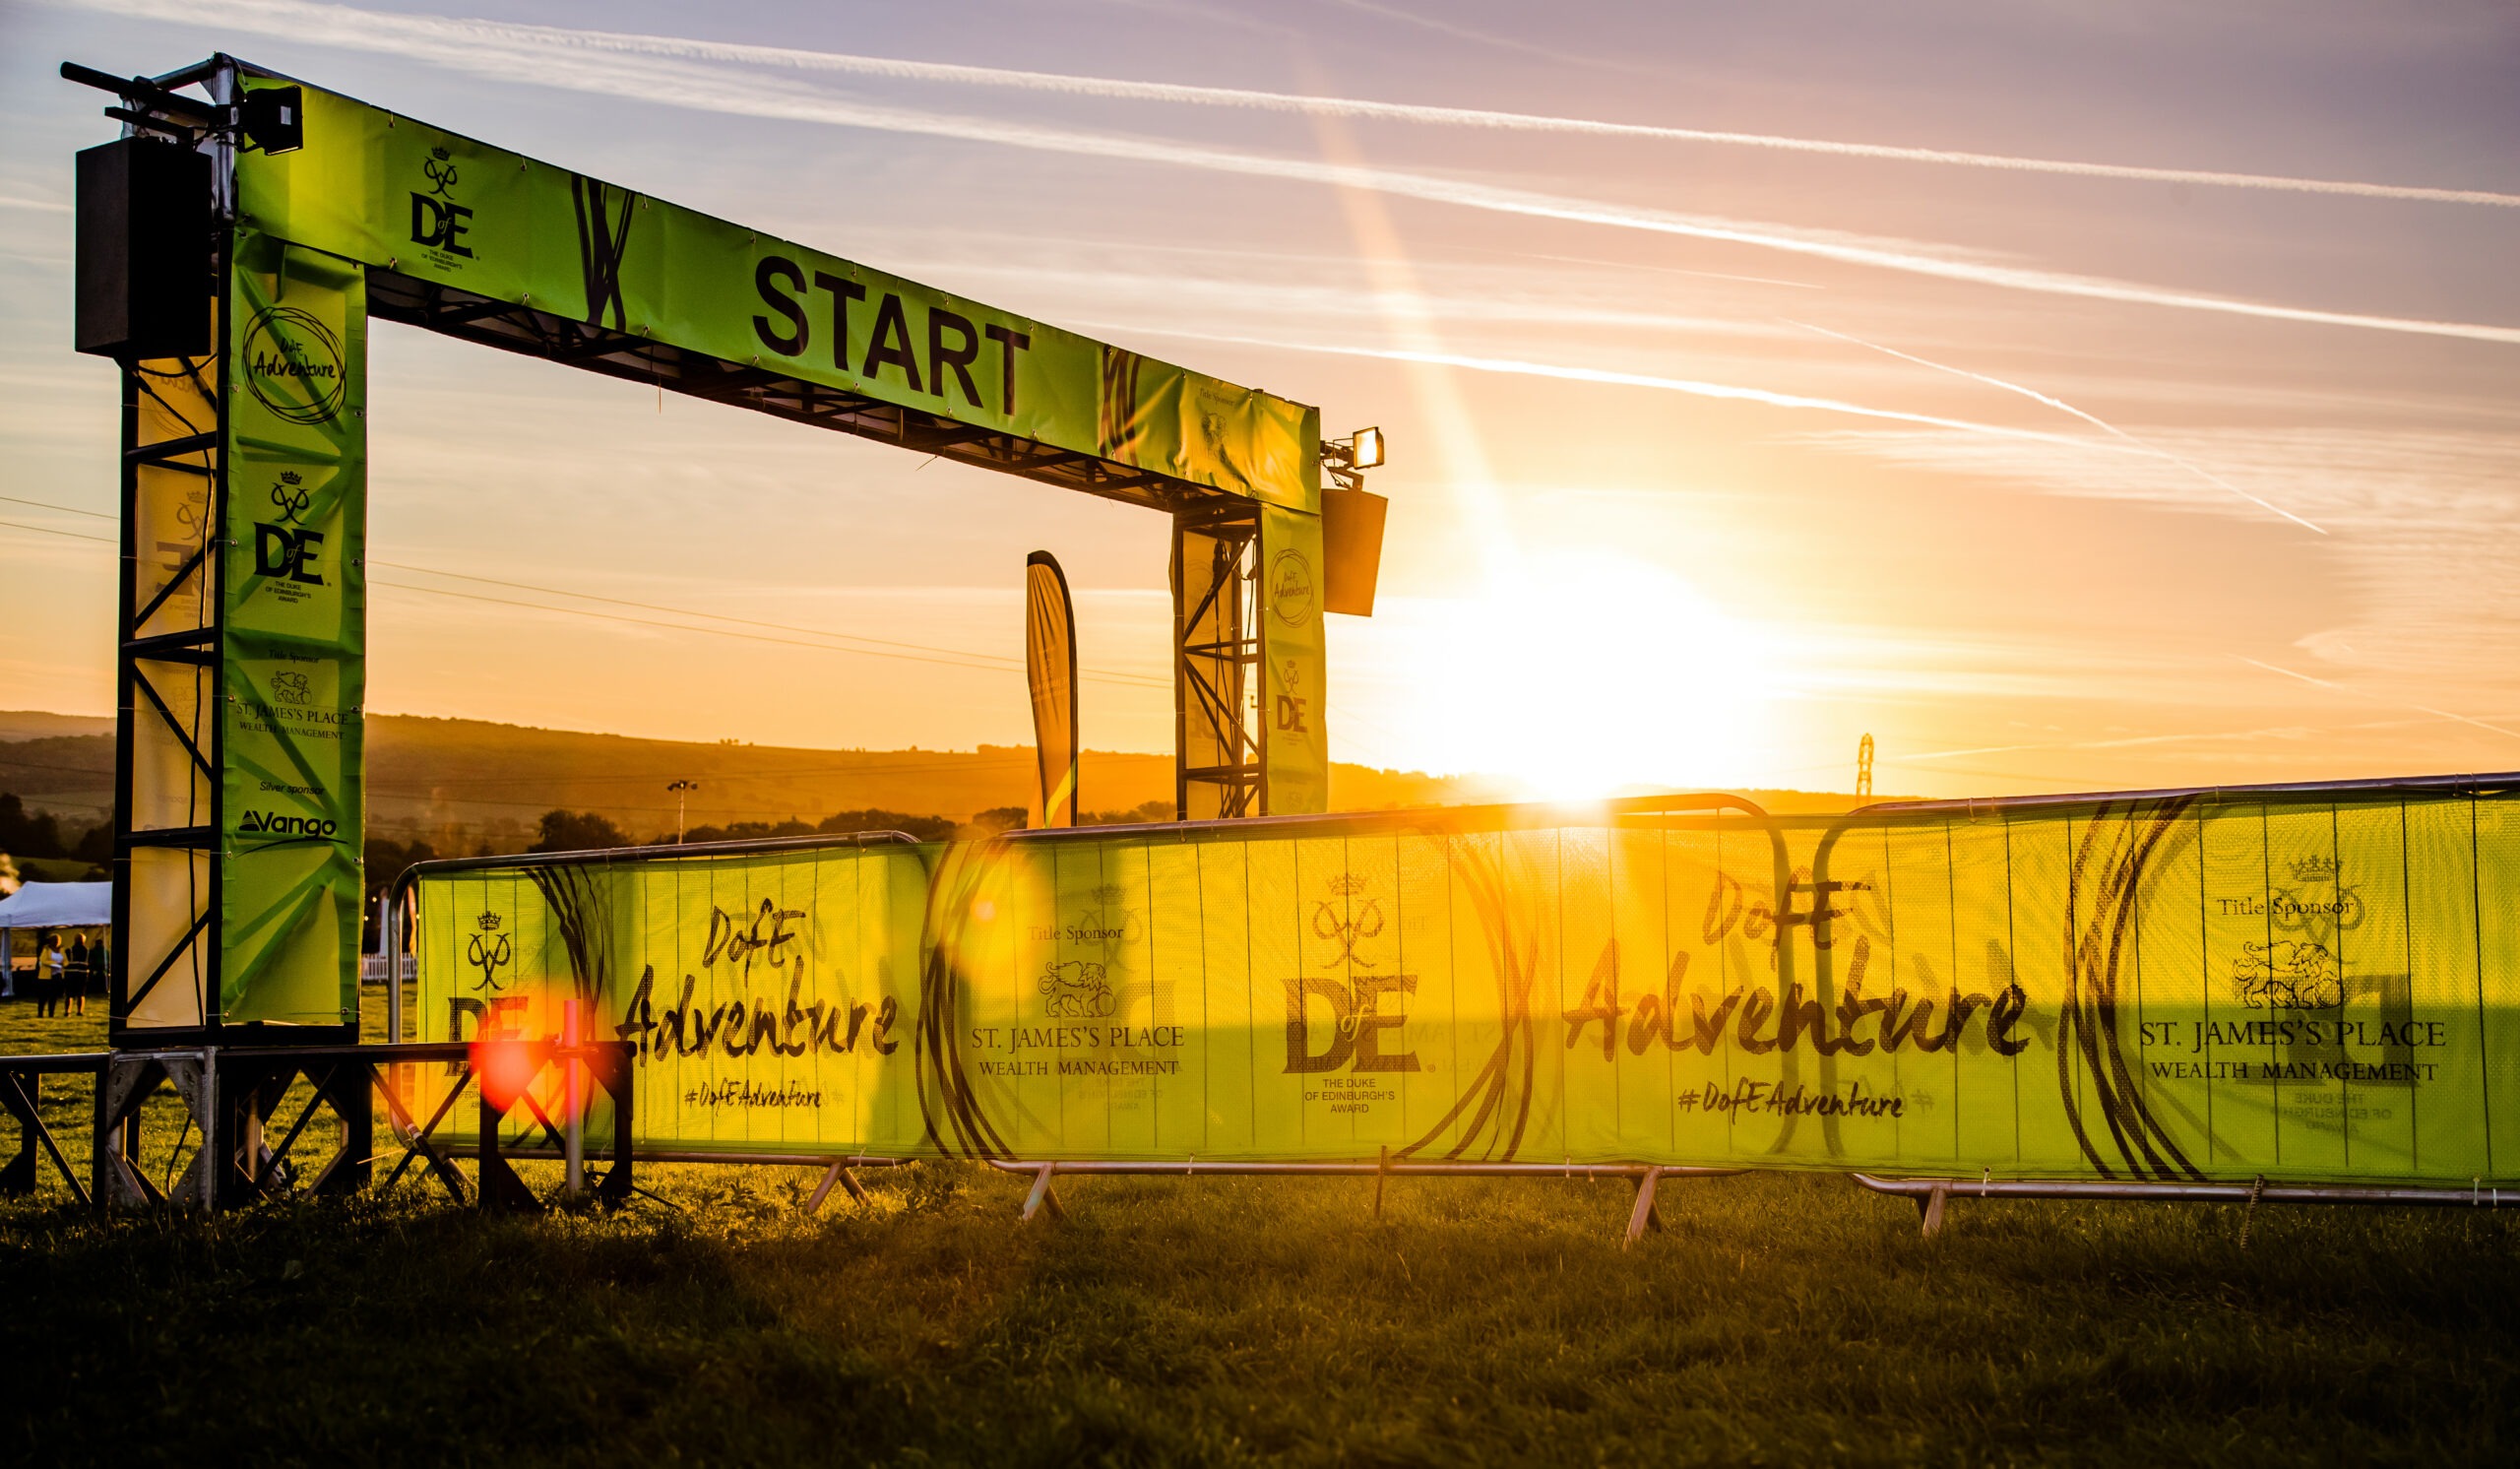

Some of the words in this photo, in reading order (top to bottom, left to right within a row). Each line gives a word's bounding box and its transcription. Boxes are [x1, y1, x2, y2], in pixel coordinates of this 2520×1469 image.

[752, 255, 1031, 416] START
[253, 351, 336, 378] Adventure
[269, 649, 287, 660] Title
[288, 651, 319, 665] Sponsor
[236, 702, 251, 717] ST.
[255, 704, 303, 721] JAMES'S
[307, 711, 348, 726] PLACE
[239, 722, 277, 734] WEALTH
[282, 727, 345, 739] MANAGEMENT
[260, 782, 285, 794] Silver
[286, 784, 325, 797] sponsor
[252, 811, 338, 839] Vango
[2218, 897, 2264, 916] Title
[2272, 897, 2355, 922] Sponsor
[1028, 926, 1060, 940] Title
[1066, 925, 1124, 945] Sponsor
[1562, 935, 2031, 1062] Adventure
[614, 955, 900, 1067] Adventure
[972, 1028, 1001, 1049] ST.
[1008, 1027, 1101, 1054] JAMES'S
[1109, 1027, 1185, 1047] PLACE
[2140, 1022, 2181, 1046] ST.
[2191, 1021, 2323, 1053] JAMES'S
[2334, 1022, 2446, 1047] PLACE
[978, 1061, 1048, 1076] WEALTH
[1057, 1060, 1179, 1076] MANAGEMENT
[2153, 1061, 2248, 1079] WEALTH
[2262, 1061, 2439, 1081] MANAGEMENT
[1322, 1079, 1344, 1088] THE
[1346, 1078, 1376, 1088] DUKE
[684, 1076, 821, 1118] #DofEAdventure
[1304, 1092, 1319, 1101] OF
[1322, 1091, 1395, 1101] EDINBURGH'S
[1677, 1075, 1905, 1124] #DofEAdventure
[1330, 1104, 1369, 1114] AWARD
